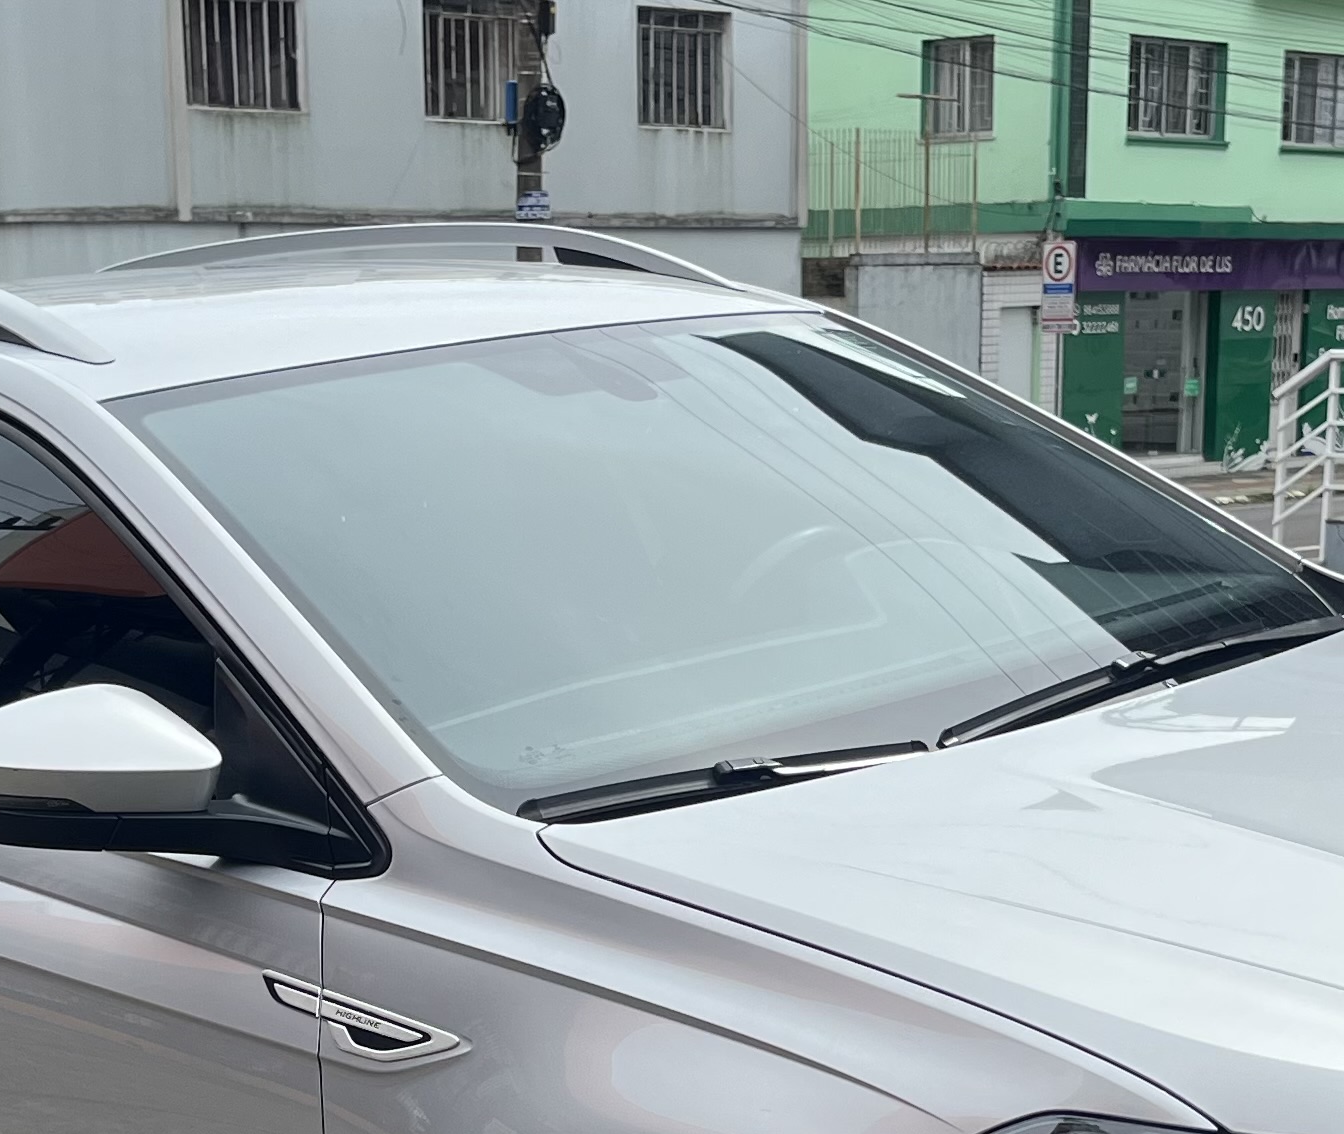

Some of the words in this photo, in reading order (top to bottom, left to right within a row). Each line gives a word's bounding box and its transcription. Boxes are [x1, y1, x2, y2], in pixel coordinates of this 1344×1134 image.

[1054, 253, 1063, 273] E
[1116, 250, 1171, 273] FARMÁCIA
[1172, 256, 1198, 273] FLOR
[1200, 256, 1214, 273] DE
[1231, 306, 1266, 332] 450
[336, 1010, 381, 1030] HIGHLINE
